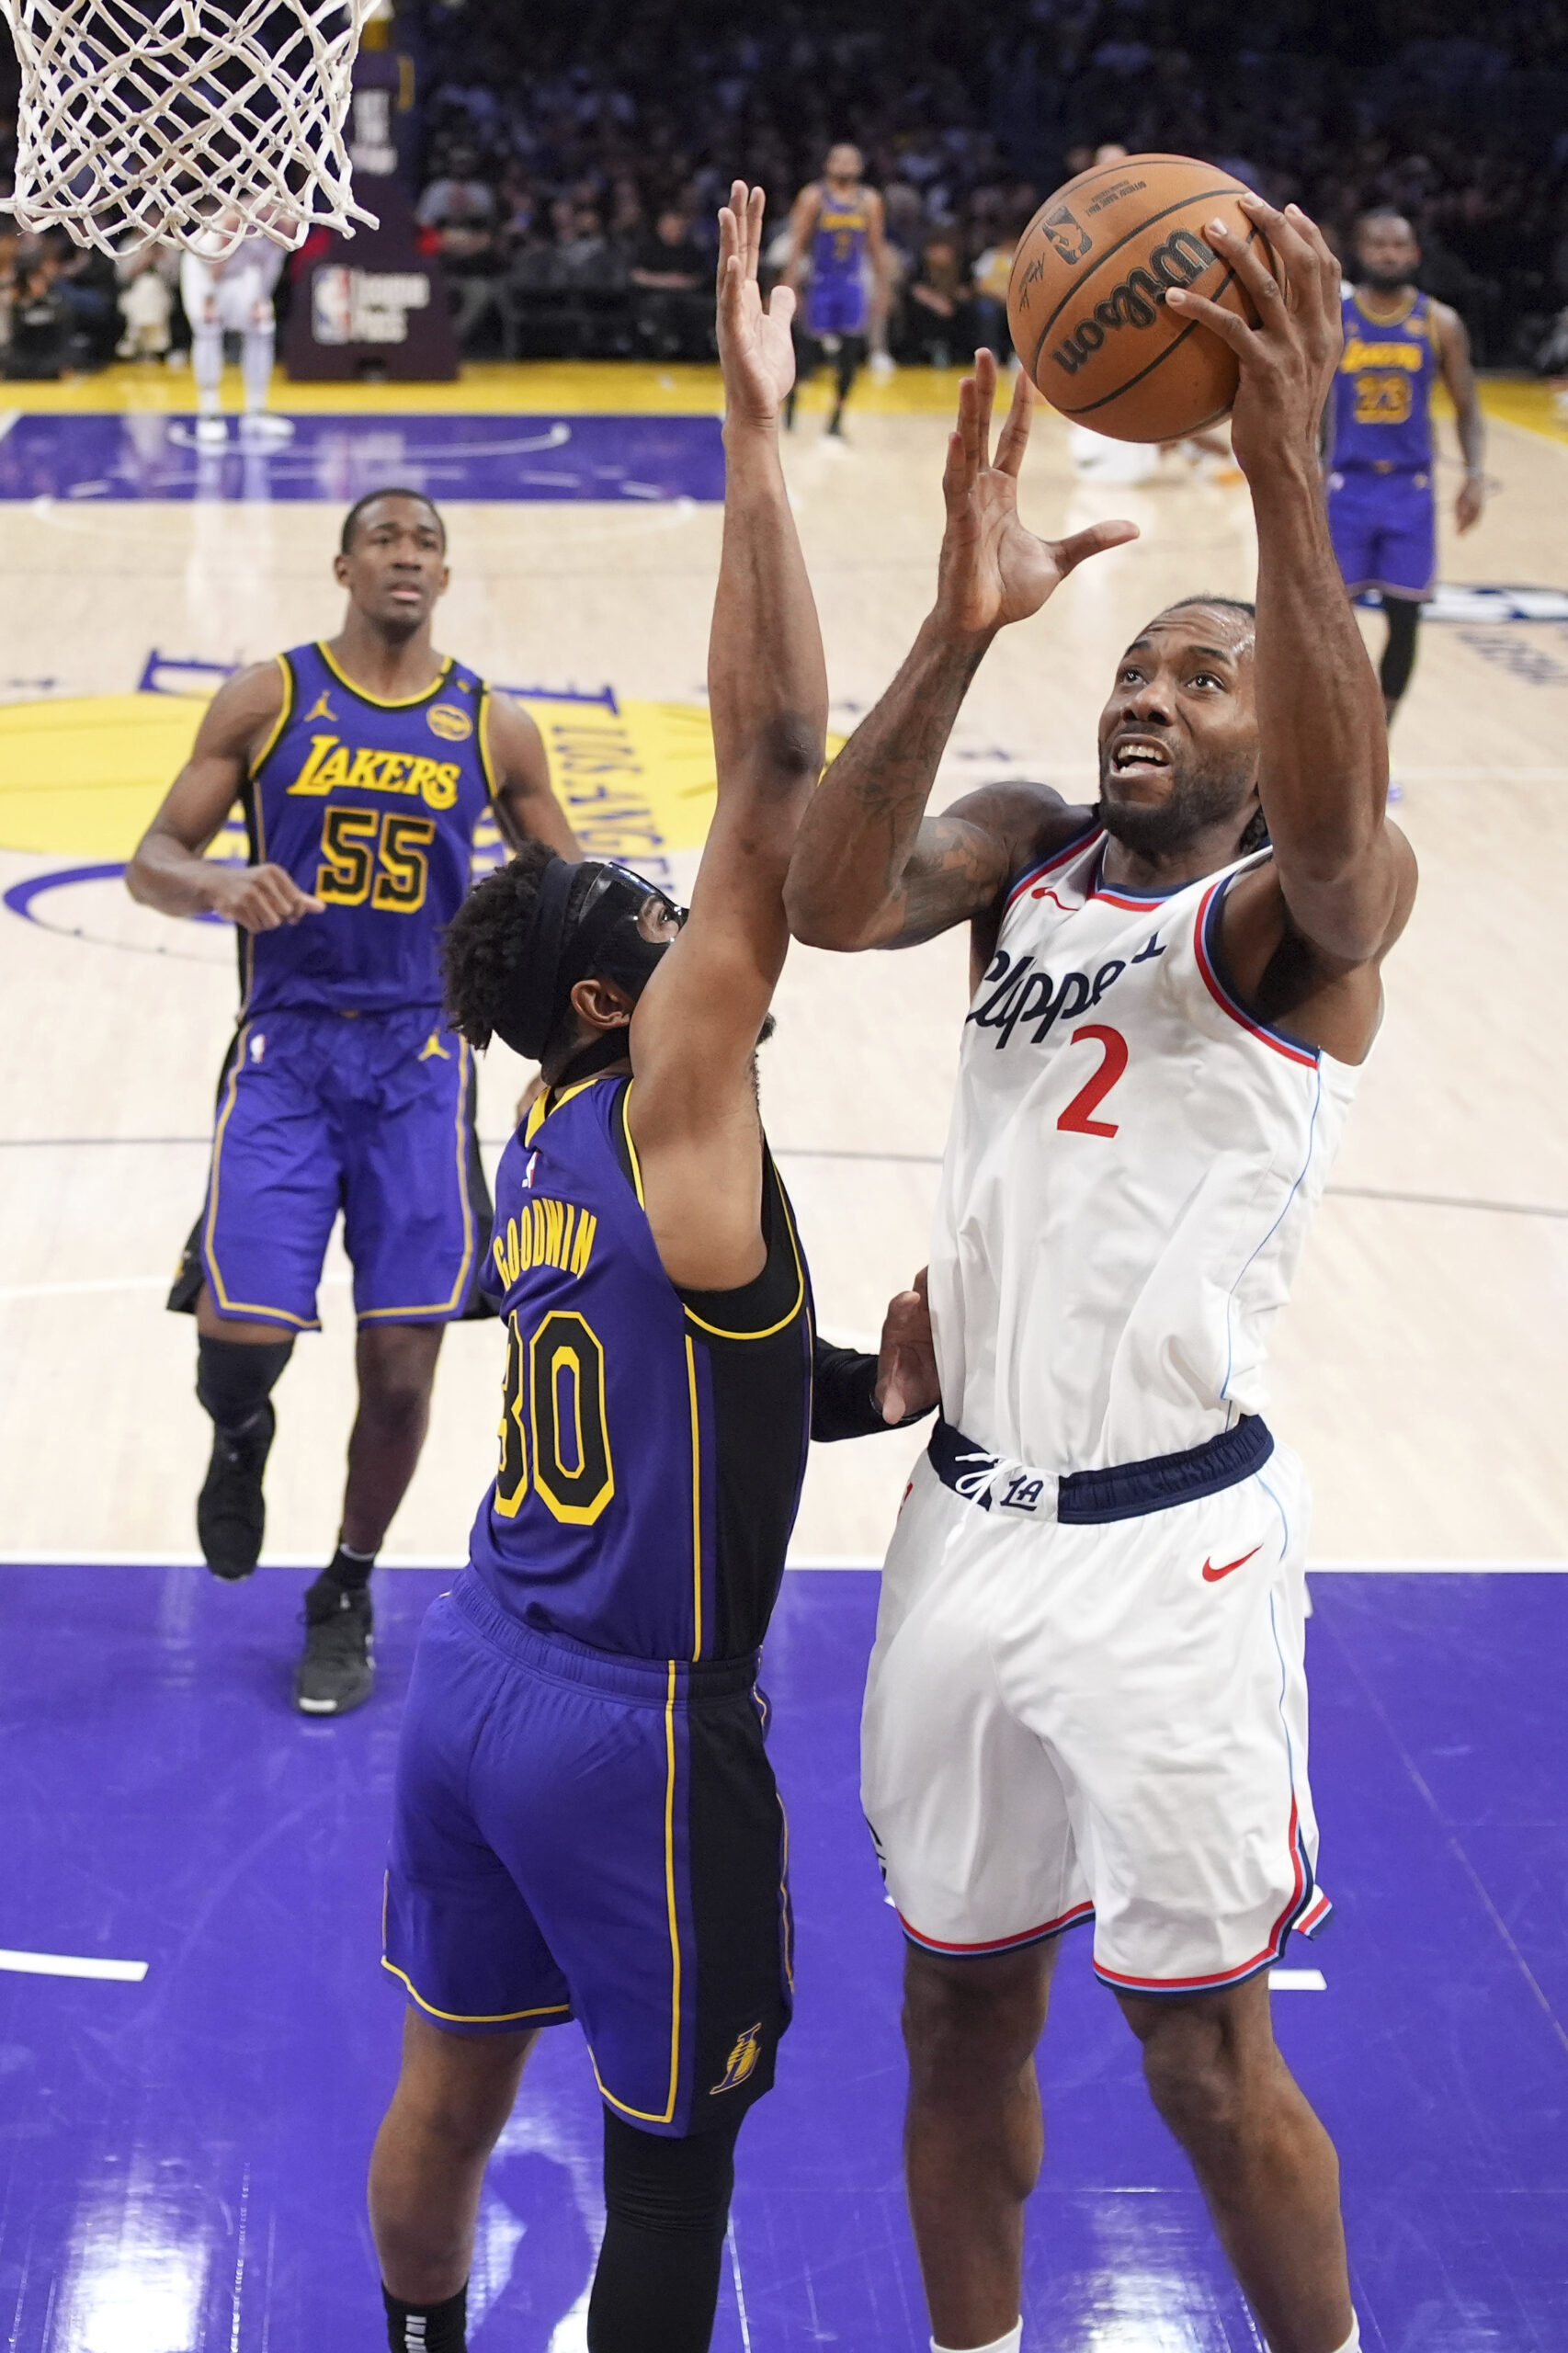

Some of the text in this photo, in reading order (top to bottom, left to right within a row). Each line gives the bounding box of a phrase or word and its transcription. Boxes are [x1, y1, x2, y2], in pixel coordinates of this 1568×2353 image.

[1353, 373, 1414, 425] 23
[286, 734, 461, 811] LAKERS
[314, 803, 437, 915] 55
[1056, 1023, 1129, 1139] 2
[492, 1197, 597, 1292] GOODWIN
[999, 1473, 1045, 1512] LA
